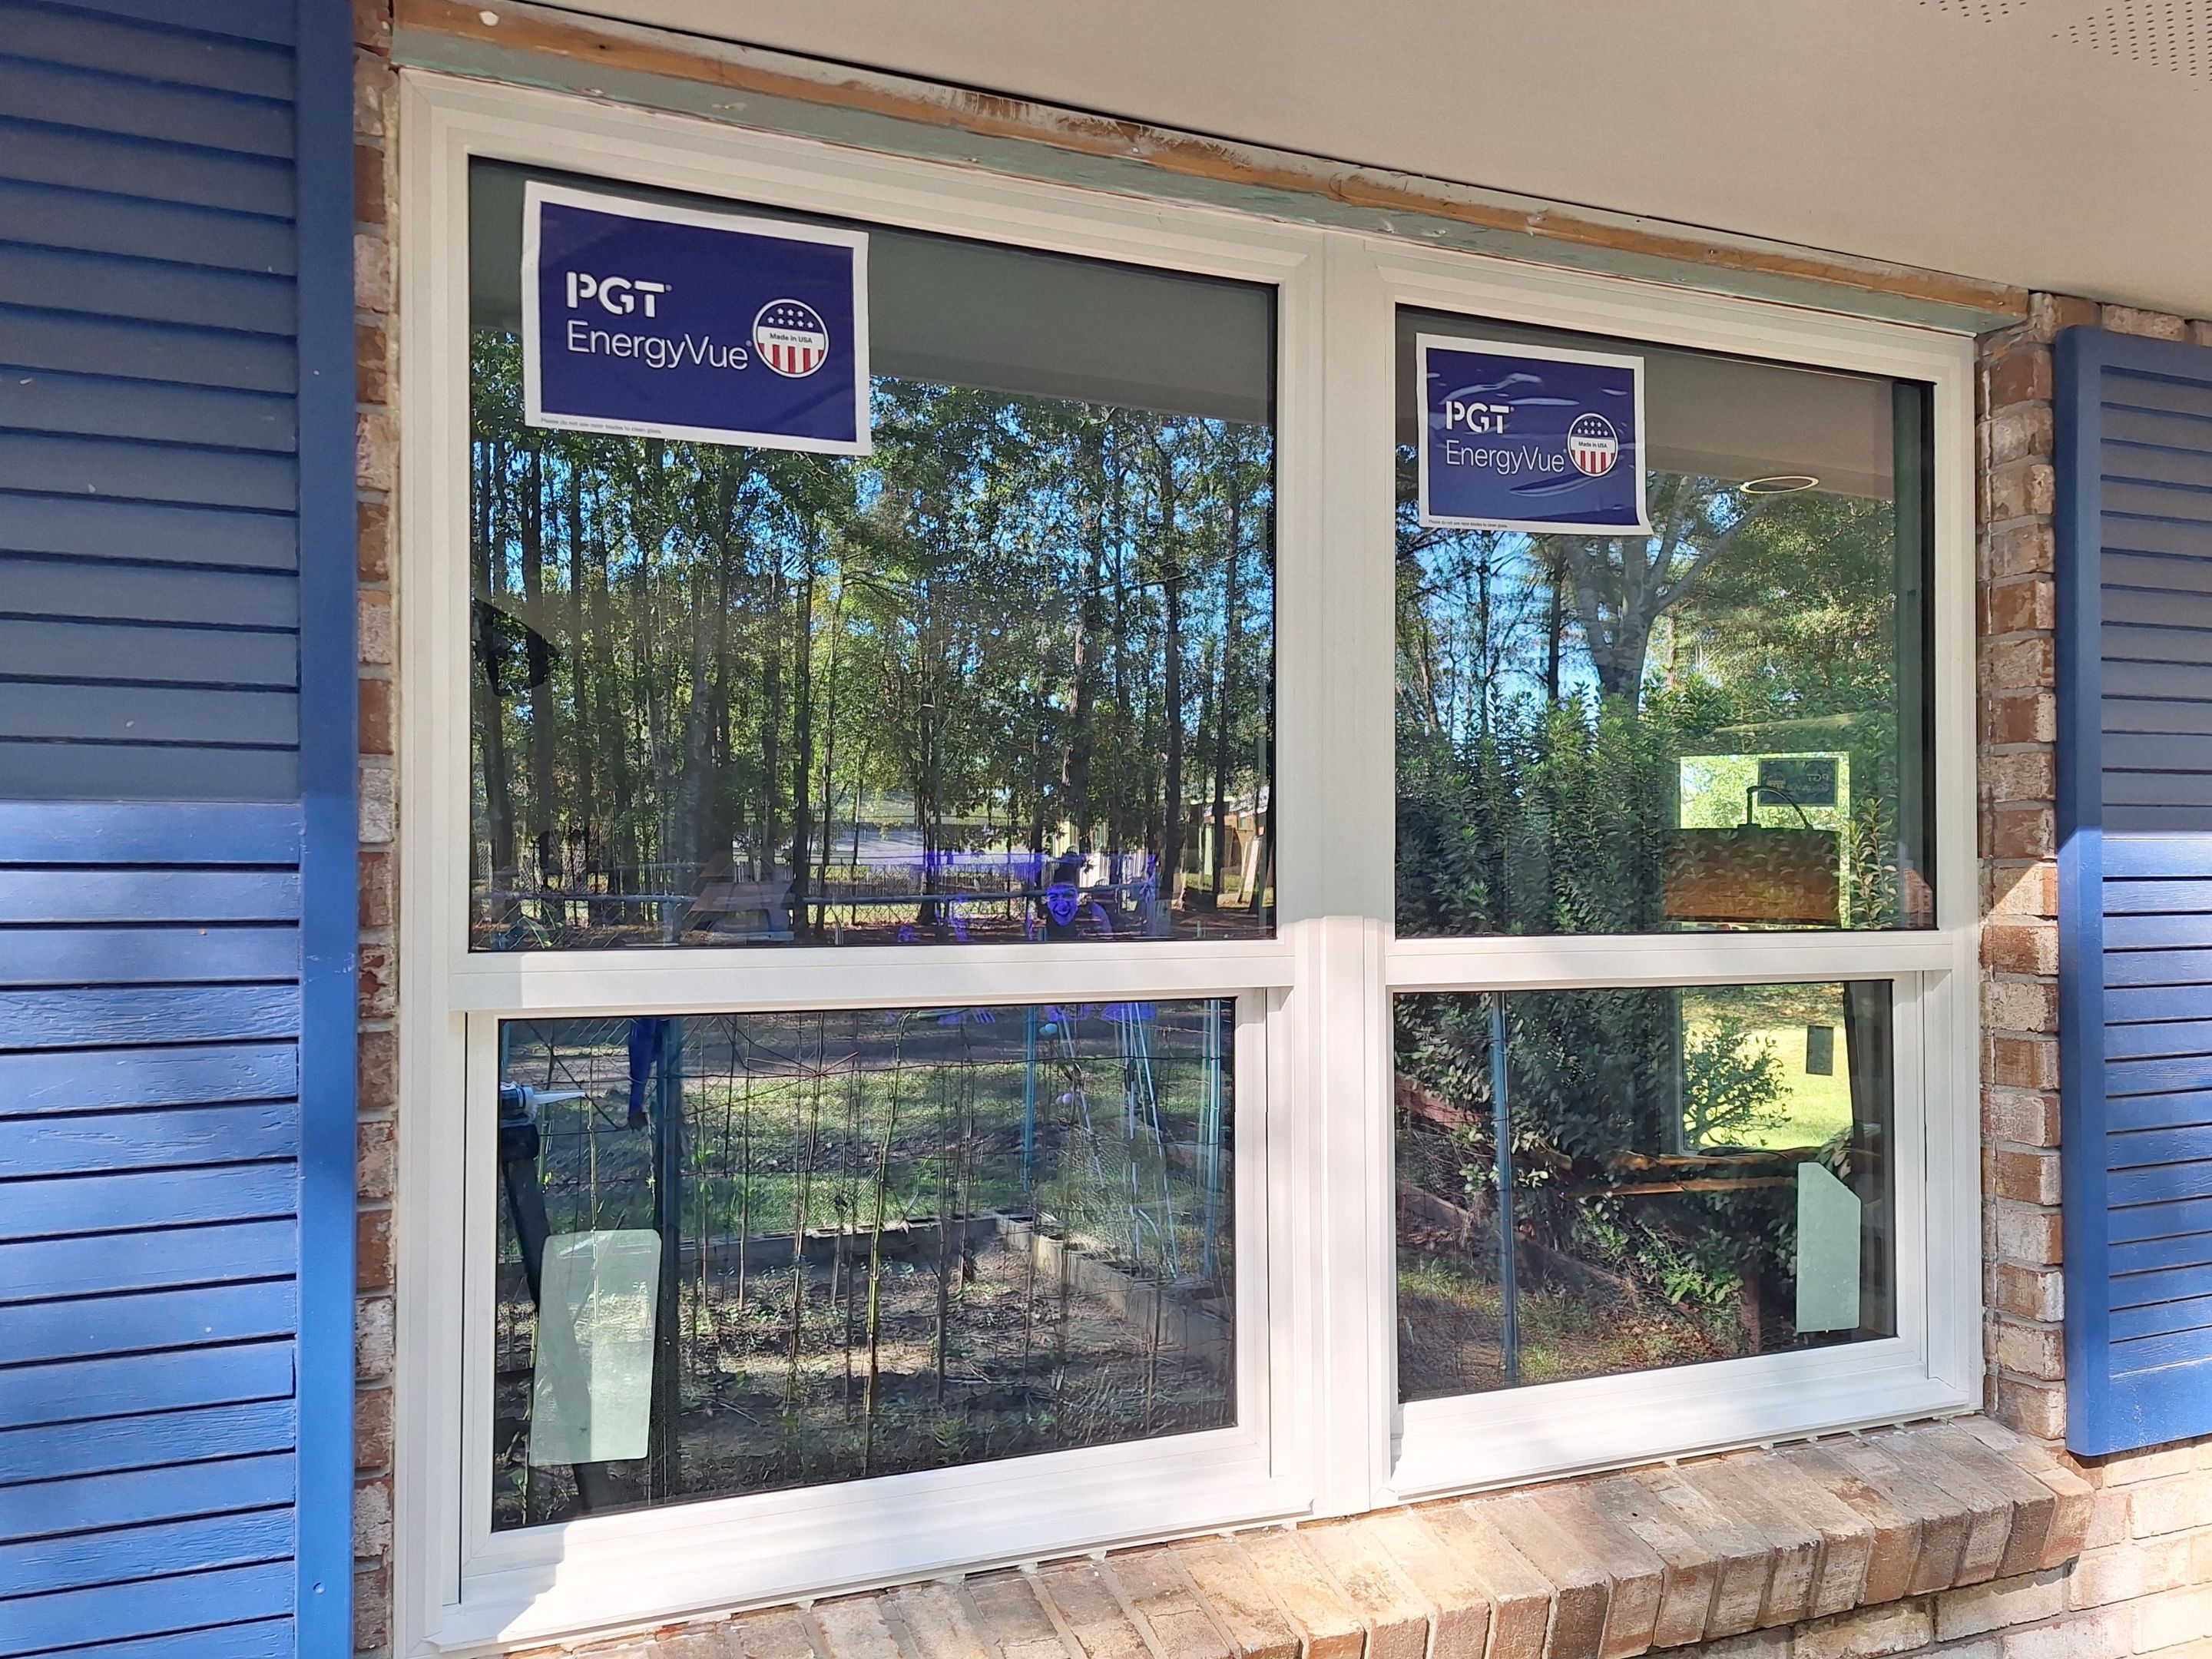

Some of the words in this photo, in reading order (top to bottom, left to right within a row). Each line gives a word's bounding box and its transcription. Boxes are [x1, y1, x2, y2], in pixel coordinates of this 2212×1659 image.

[565, 270, 666, 318] PGT
[566, 318, 749, 370] EnergyVue
[770, 333, 789, 341] Made
[1445, 400, 1510, 434] PGT
[1445, 439, 1565, 475] EnergyVue
